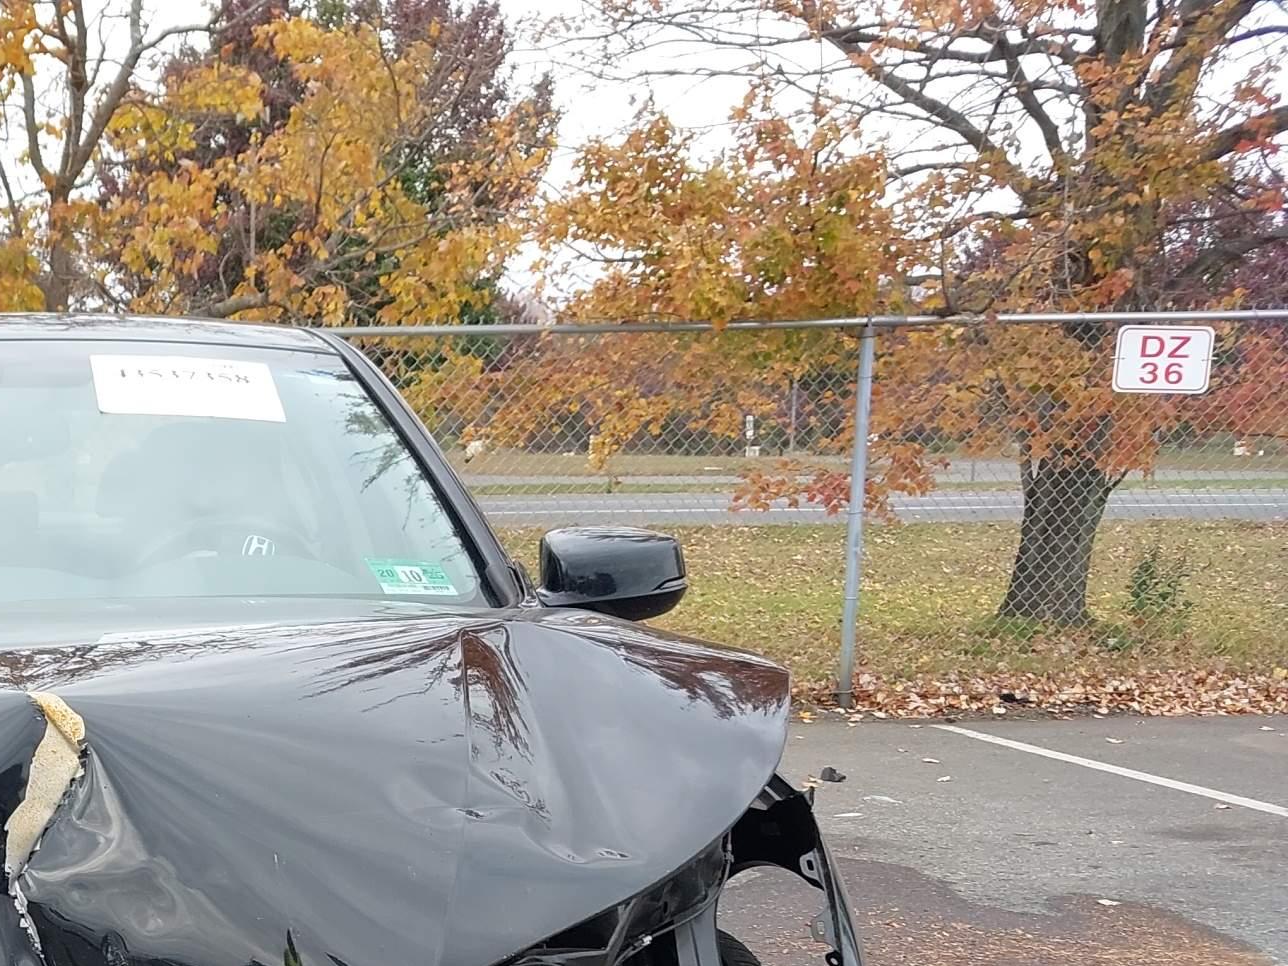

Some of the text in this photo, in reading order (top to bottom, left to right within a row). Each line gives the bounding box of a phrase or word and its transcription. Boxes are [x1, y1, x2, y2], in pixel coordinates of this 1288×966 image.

[1140, 335, 1192, 359] DZ
[1138, 362, 1184, 385] 36
[377, 568, 394, 578] 20
[400, 569, 423, 583] 10
